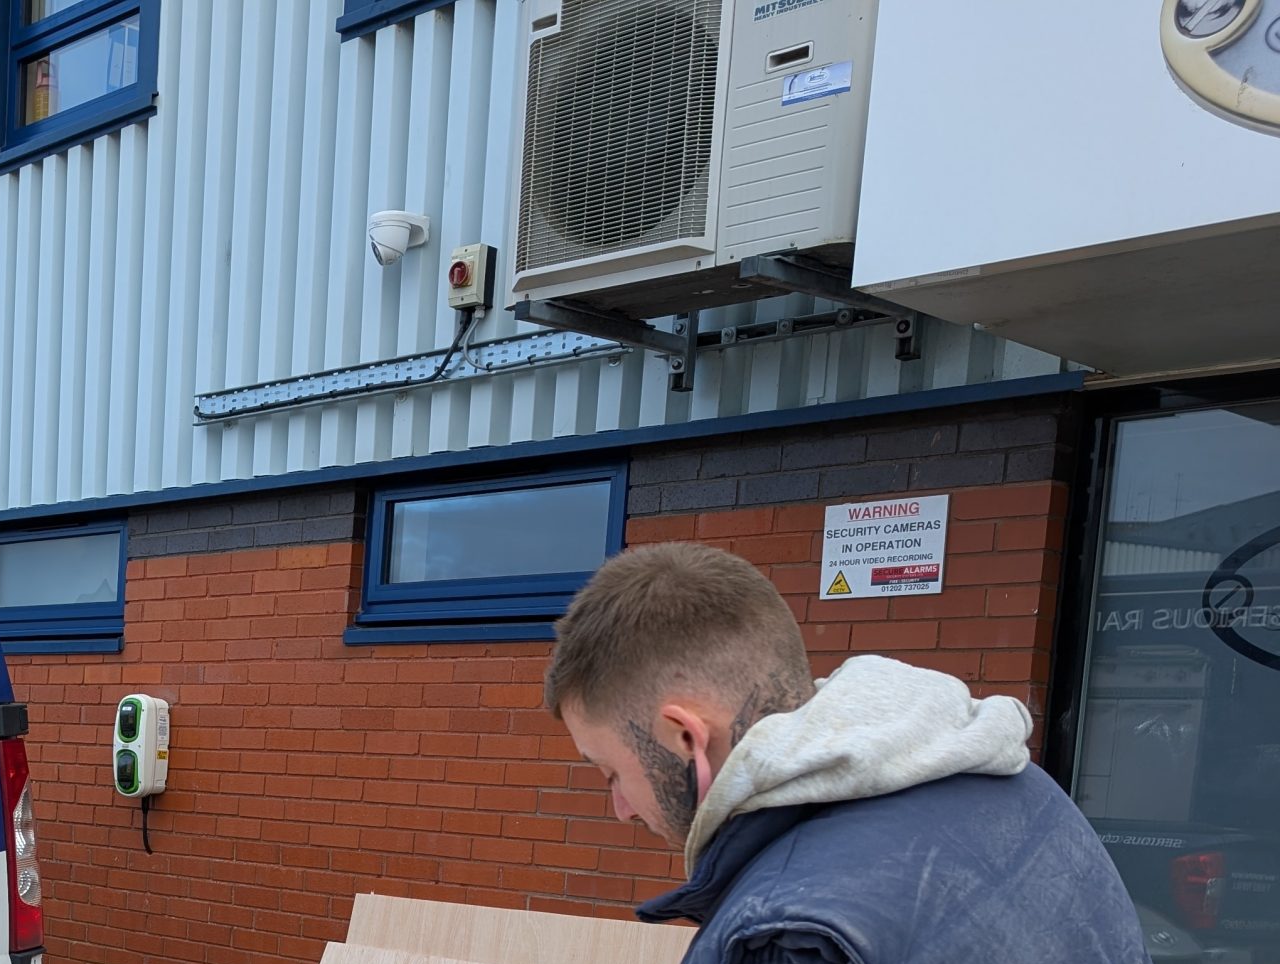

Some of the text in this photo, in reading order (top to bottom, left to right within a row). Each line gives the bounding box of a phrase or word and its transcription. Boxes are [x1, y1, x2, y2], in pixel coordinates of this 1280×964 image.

[754, 11, 775, 21] HEAVY
[848, 502, 920, 520] WARNING
[826, 520, 941, 539] SECURITY CAMERAS
[842, 538, 922, 553] IN OPERATION
[839, 558, 861, 567] HOUR
[862, 556, 885, 564] VIDEO
[887, 553, 933, 563] RECORDING
[903, 565, 937, 574] ALARMS
[881, 585, 903, 593] 01202
